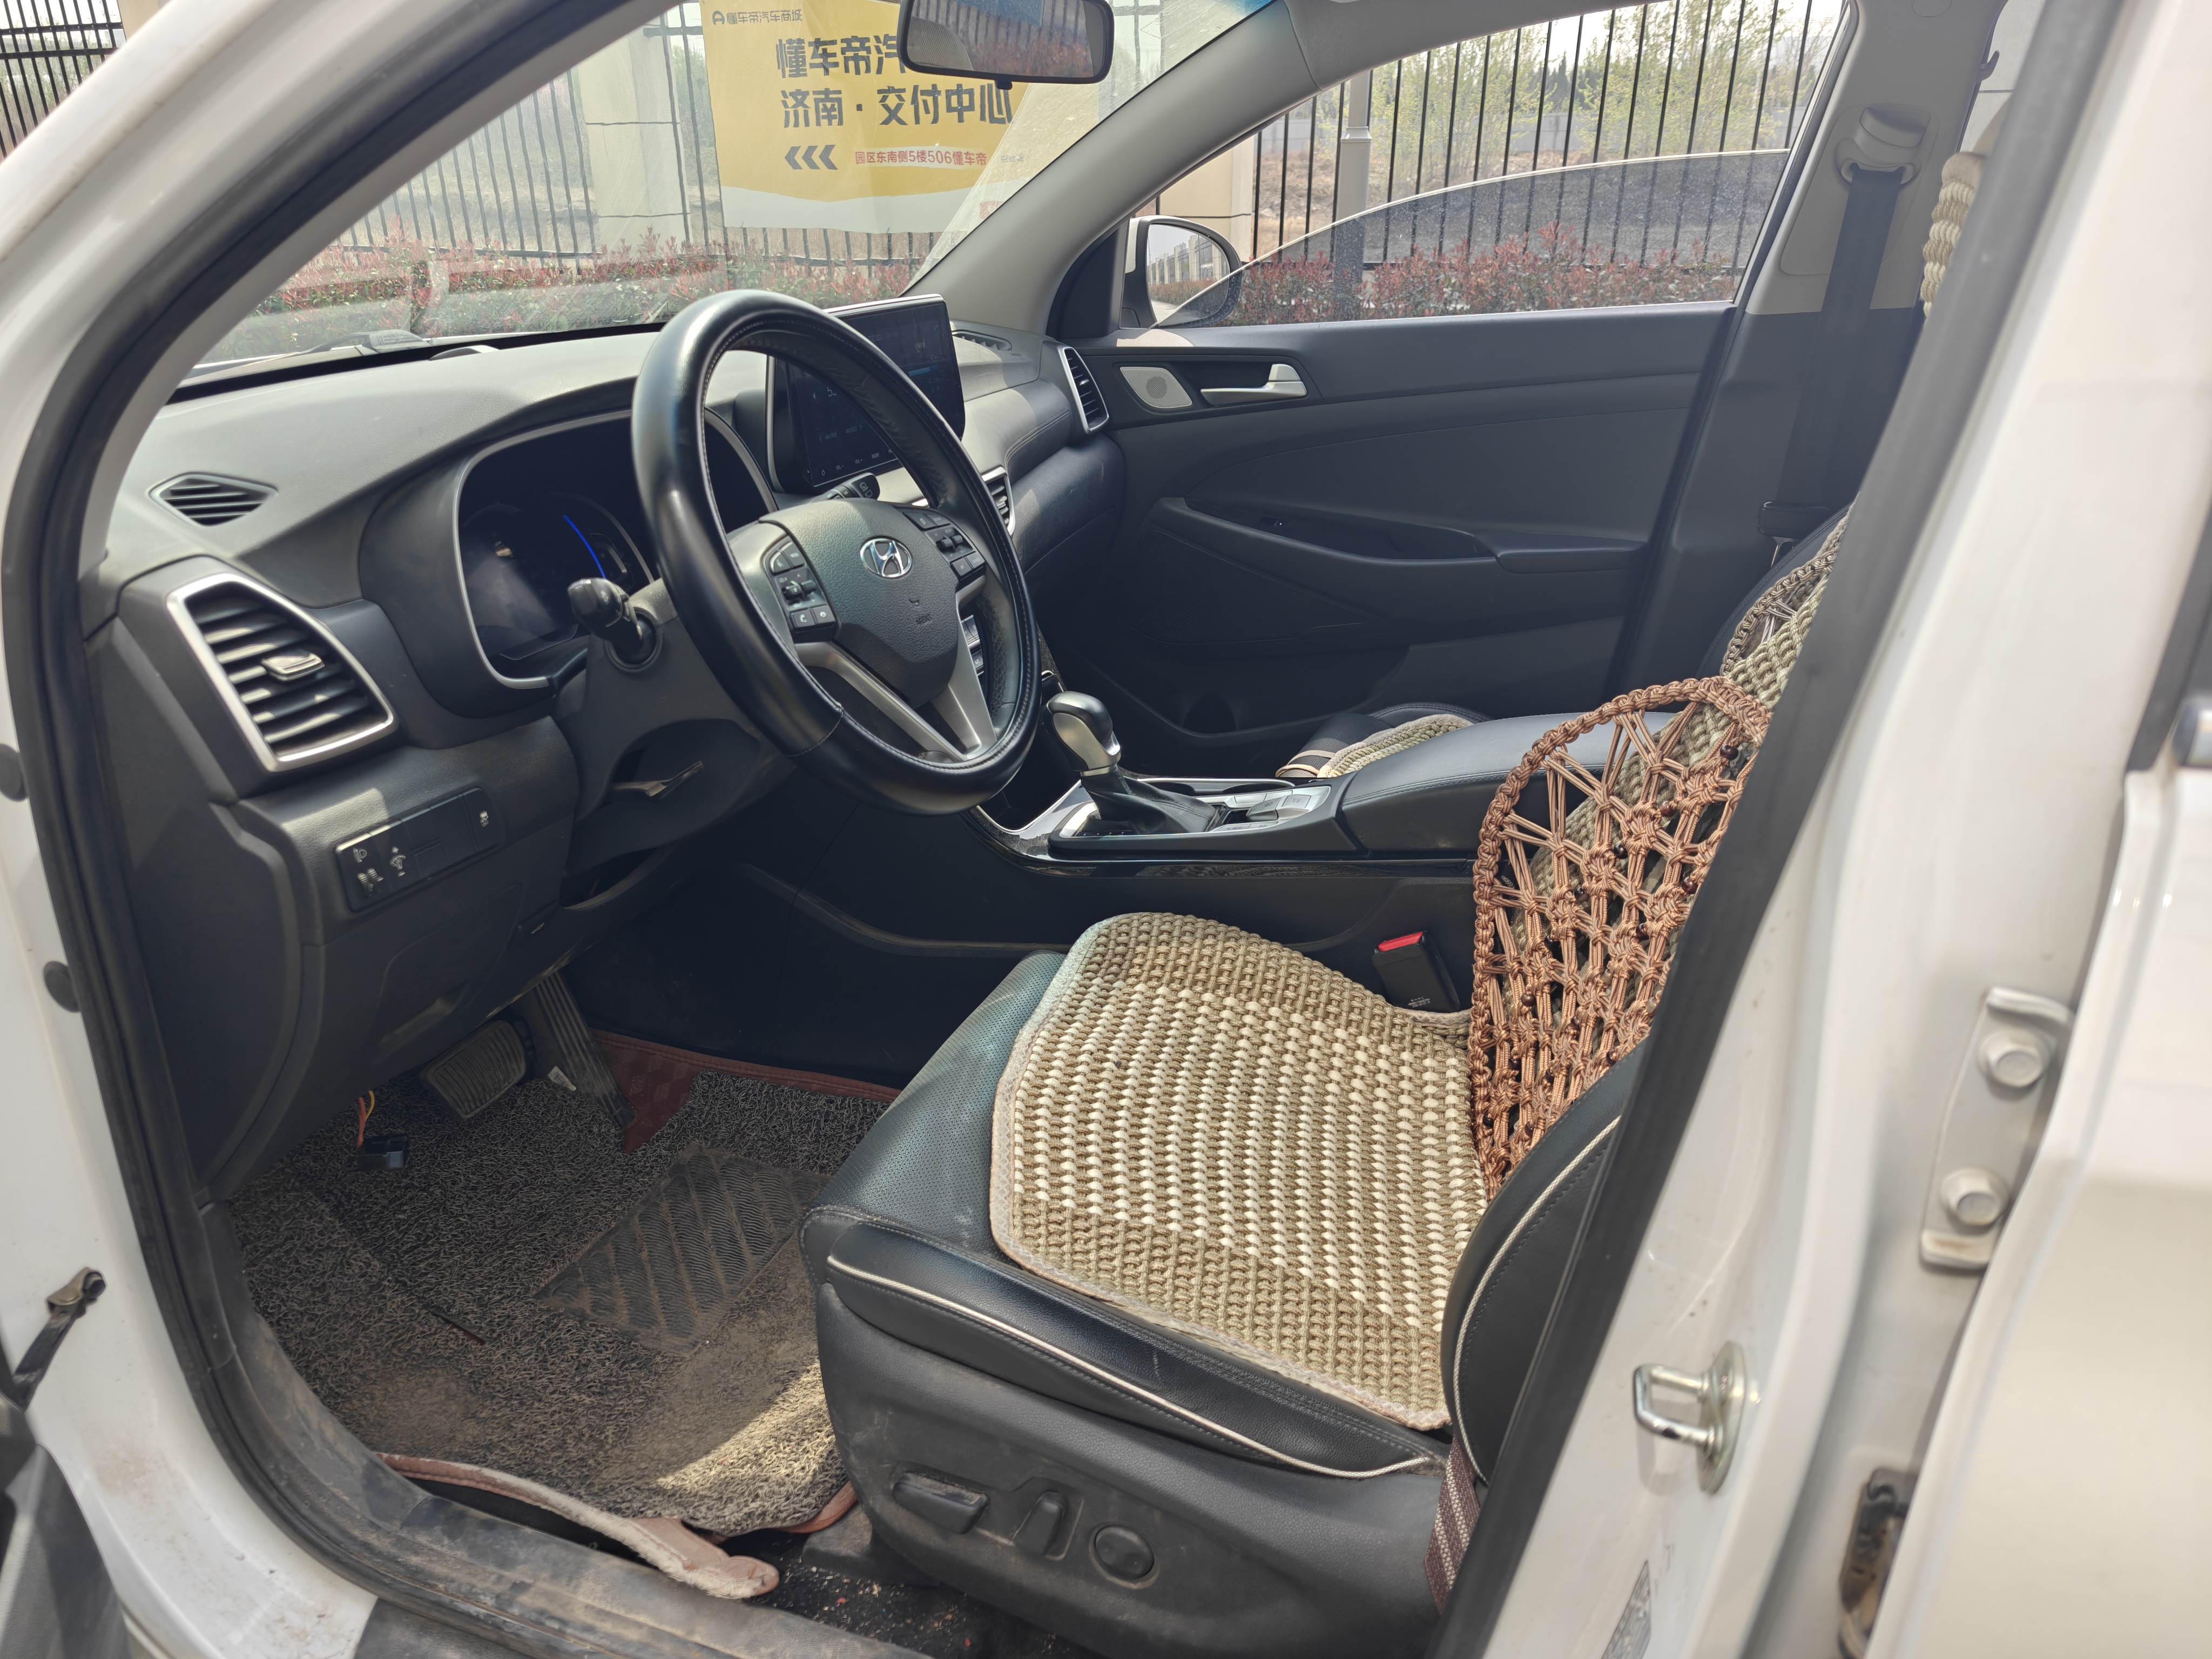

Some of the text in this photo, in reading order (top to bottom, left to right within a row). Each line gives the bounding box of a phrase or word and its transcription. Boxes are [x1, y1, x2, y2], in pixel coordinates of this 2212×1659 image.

[726, 9, 803, 25] 懂车帝汽车商城
[855, 150, 987, 166] 园区东南侧5楼506懂车帝
